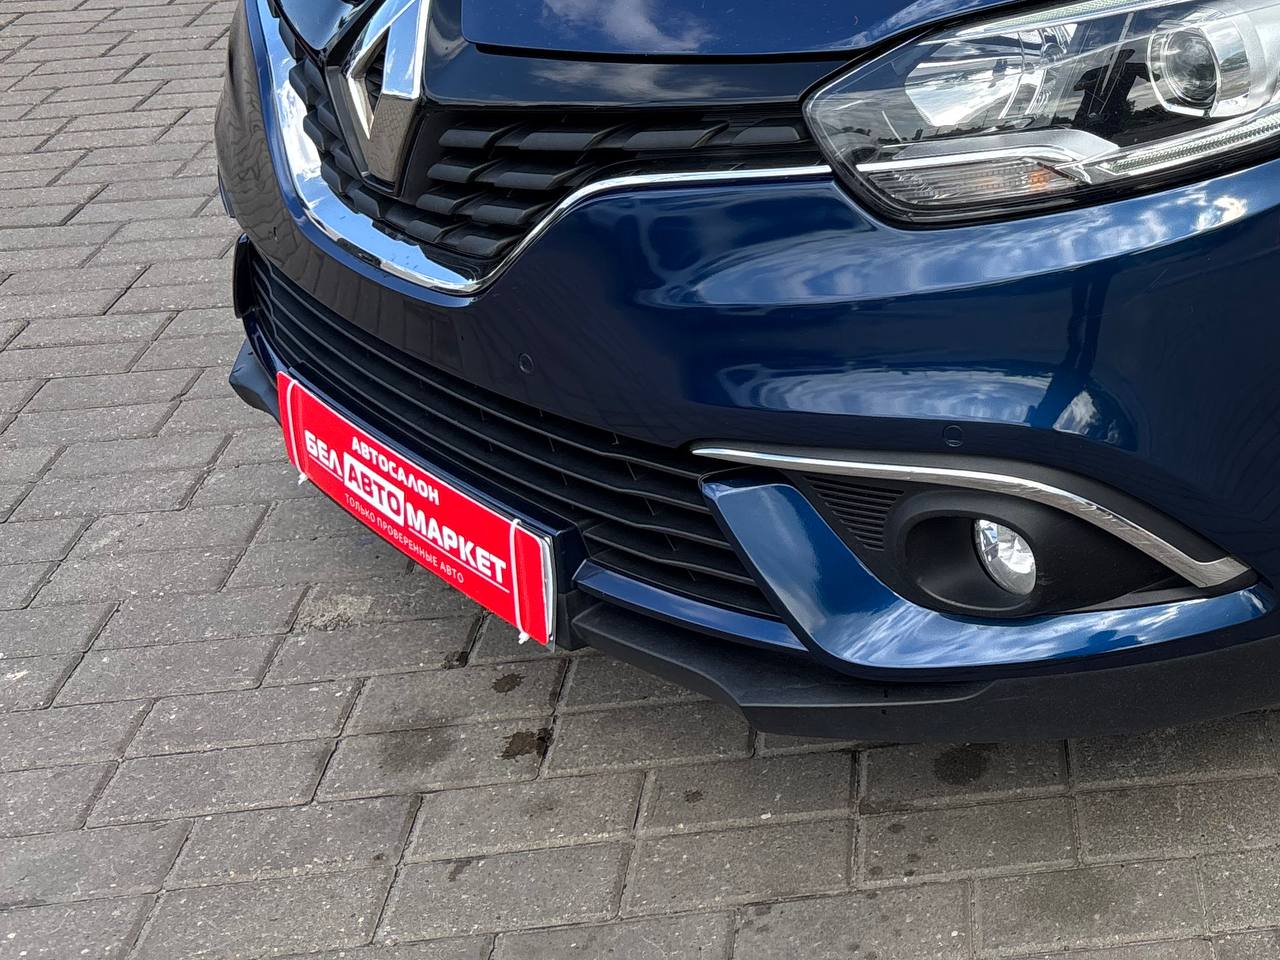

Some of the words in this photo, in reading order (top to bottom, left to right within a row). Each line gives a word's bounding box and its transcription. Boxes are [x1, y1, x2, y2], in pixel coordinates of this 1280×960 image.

[352, 436, 440, 506] АВТОСАЛОН
[345, 493, 376, 523] ТОЛЬКО
[376, 516, 438, 567] ПРОВЕРЕННЫЕ
[440, 562, 464, 584] АВТО
